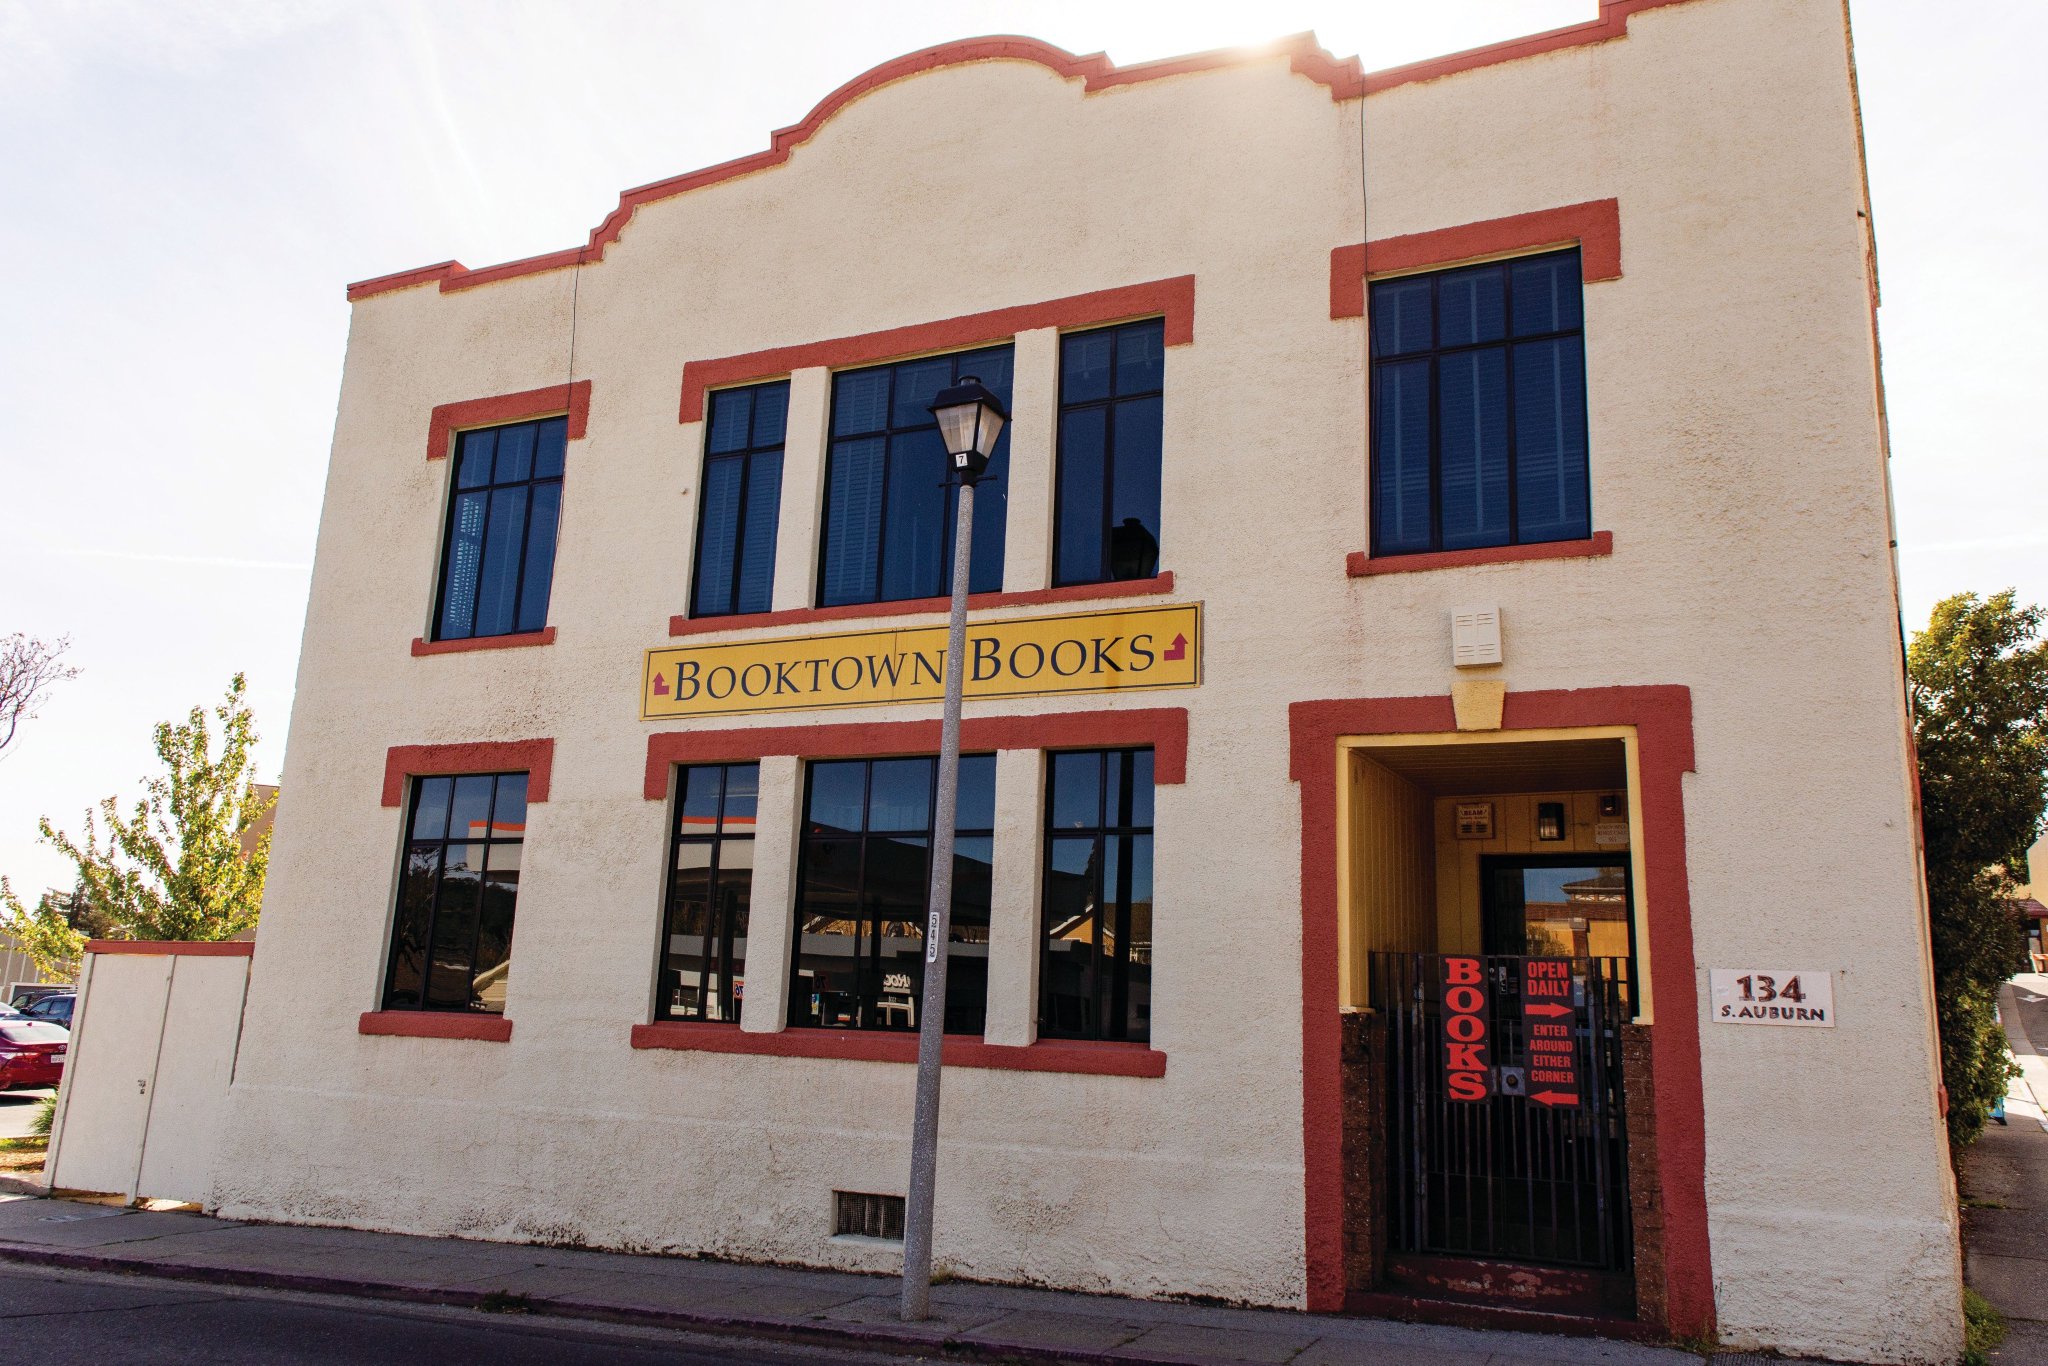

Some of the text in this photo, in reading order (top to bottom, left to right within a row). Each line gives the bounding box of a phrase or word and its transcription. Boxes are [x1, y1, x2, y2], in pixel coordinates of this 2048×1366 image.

[958, 455, 965, 464] 7
[674, 633, 1155, 701] BOOKTOWN BOOKS
[1527, 961, 1568, 979] OPEN
[1527, 979, 1570, 997] DAILY
[1736, 974, 1807, 1003] 134
[1445, 957, 1488, 1100] BOOKS
[1533, 1024, 1568, 1037] ENTER
[1529, 1039, 1573, 1053] AROUND
[1533, 1054, 1571, 1068] EITHER
[1531, 1070, 1574, 1083] CORNER
